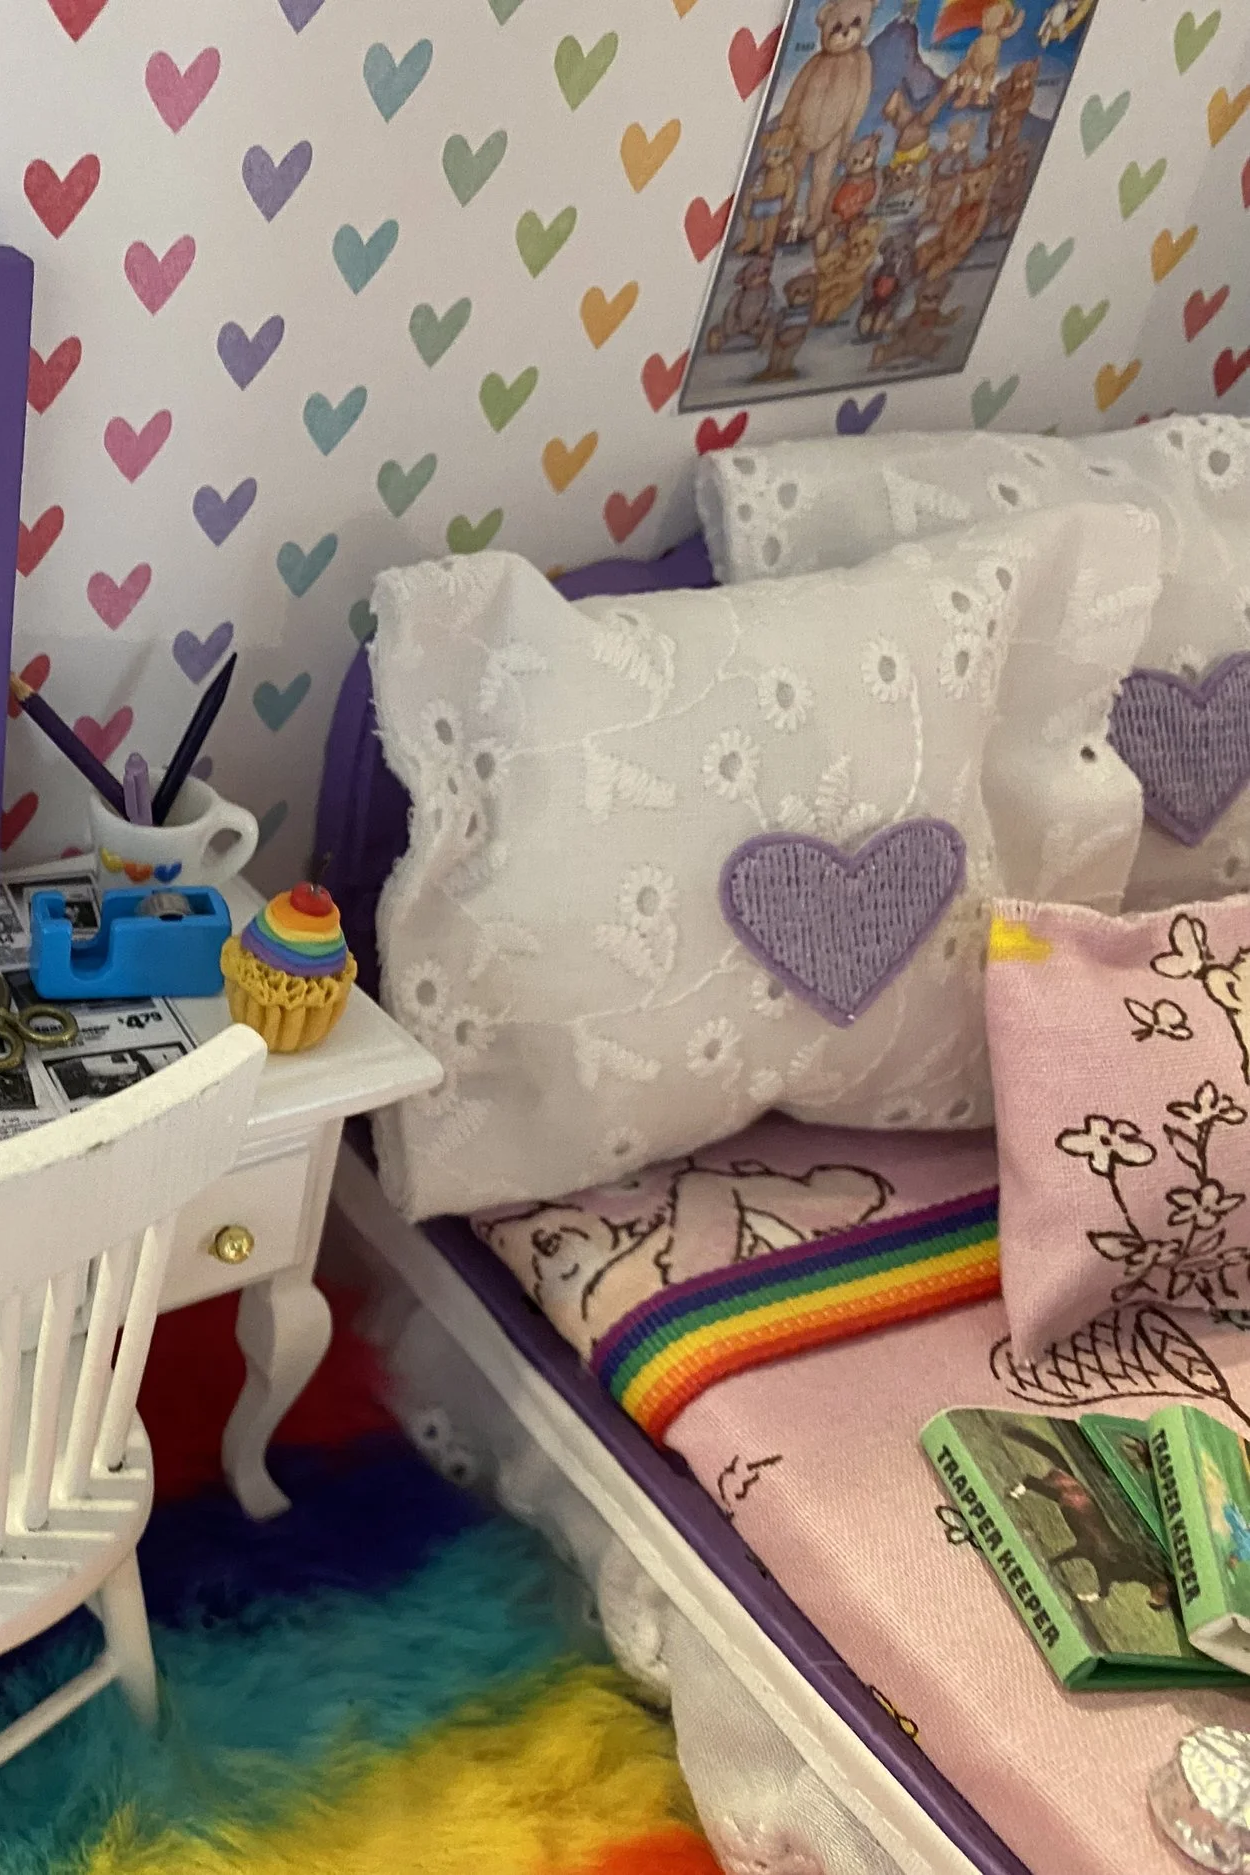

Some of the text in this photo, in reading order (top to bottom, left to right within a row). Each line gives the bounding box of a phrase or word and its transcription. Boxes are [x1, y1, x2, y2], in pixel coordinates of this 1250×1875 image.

[937, 1443, 1061, 1650] TRAPPER KEEPER
[1151, 1427, 1201, 1606] TRAPPER KEEPER
